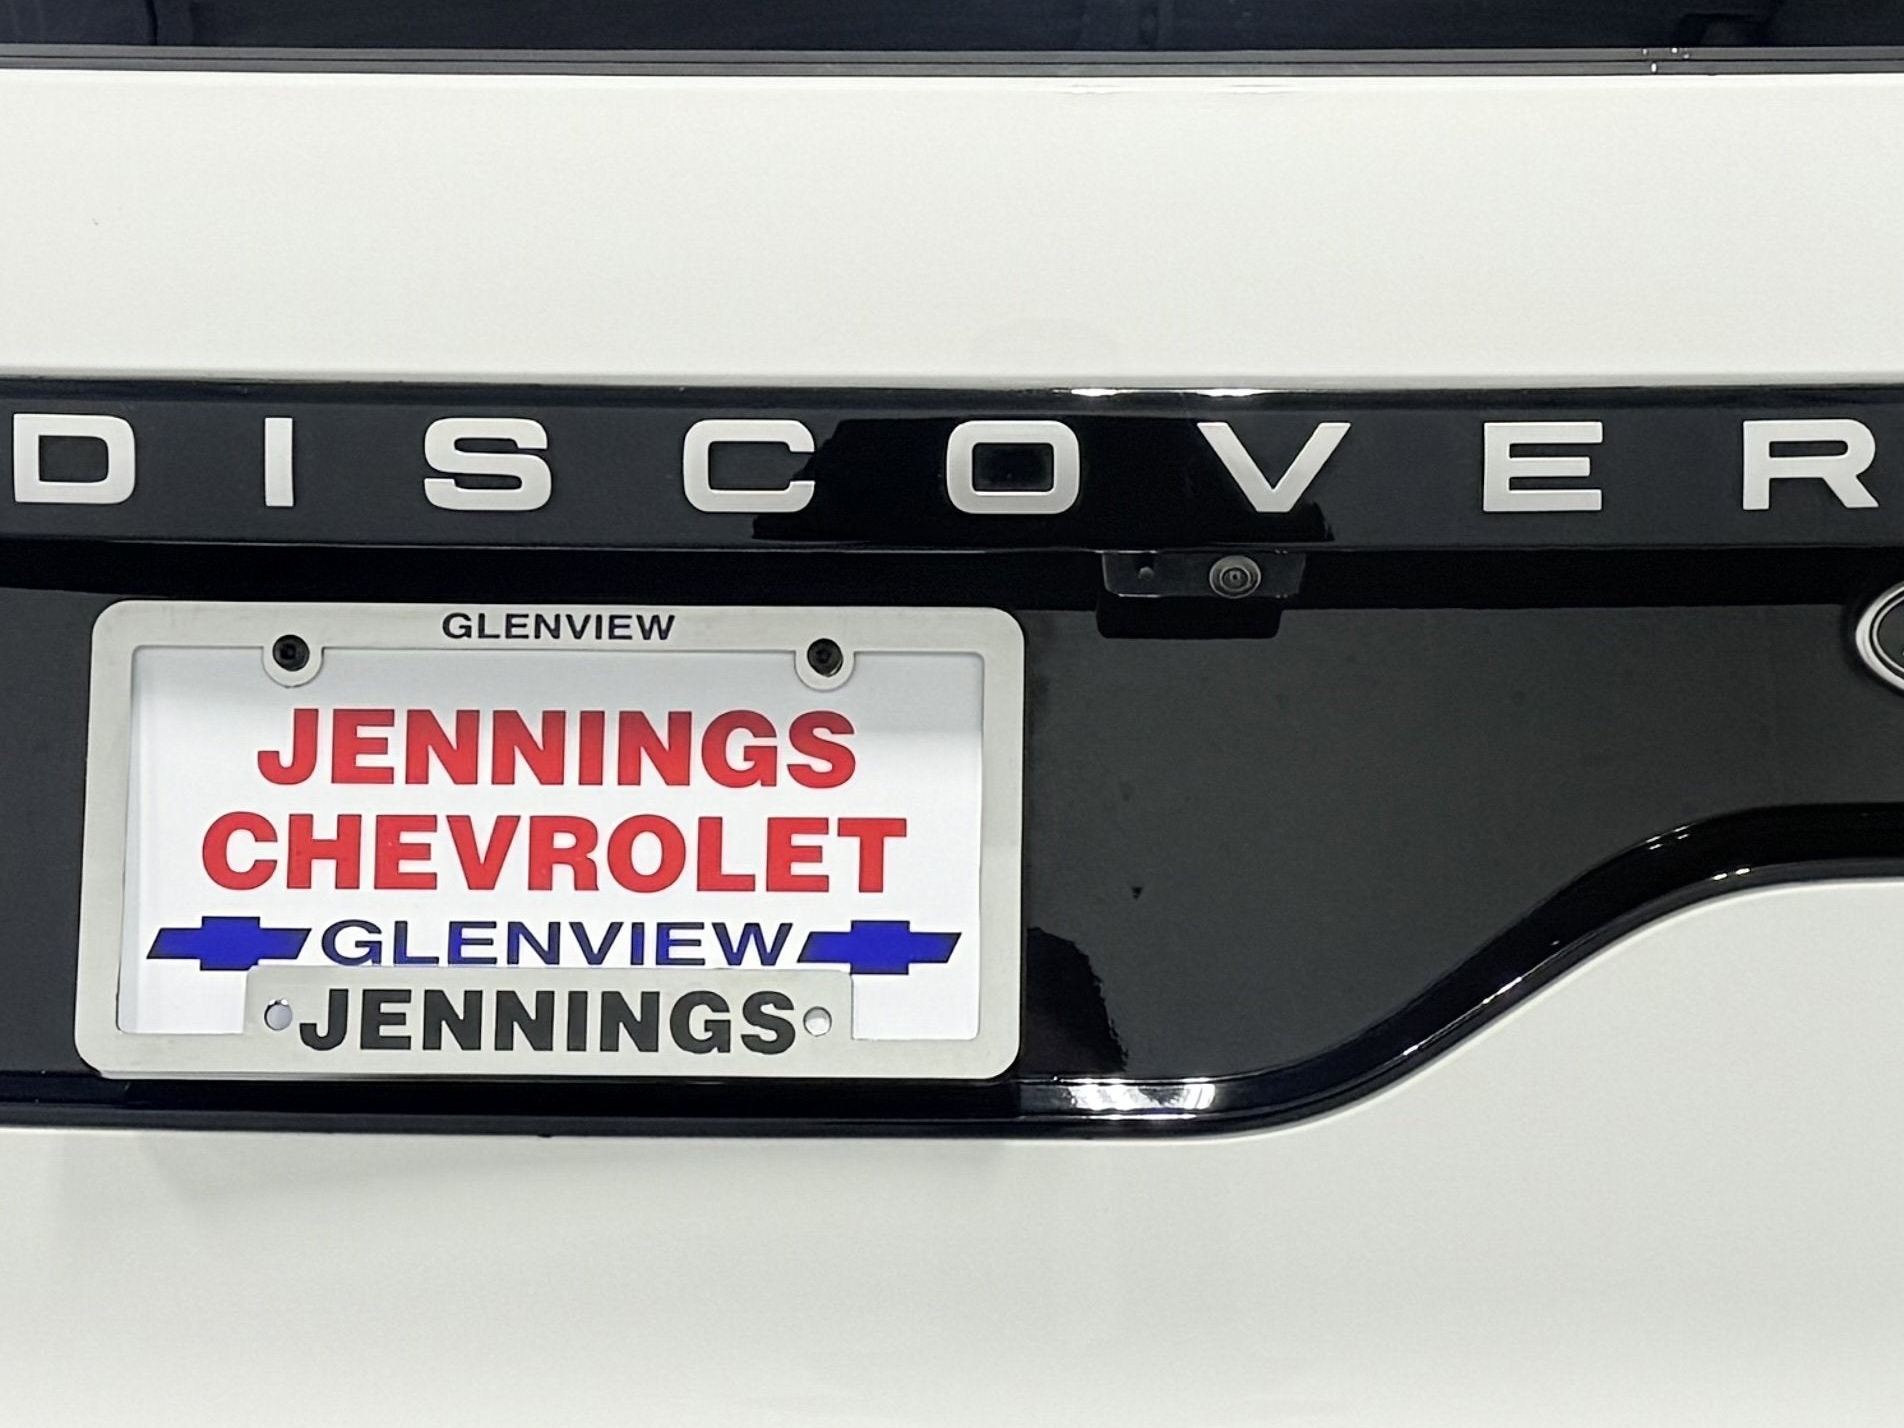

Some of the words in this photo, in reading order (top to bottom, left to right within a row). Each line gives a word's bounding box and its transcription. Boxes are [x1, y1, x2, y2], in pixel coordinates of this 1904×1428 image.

[442, 612, 676, 641] GLENVIEW
[257, 708, 856, 790] JENNINGS
[201, 811, 908, 894] CHEVROLET
[320, 918, 794, 967] GLENVIEW
[298, 987, 797, 1056] JENNINGS
